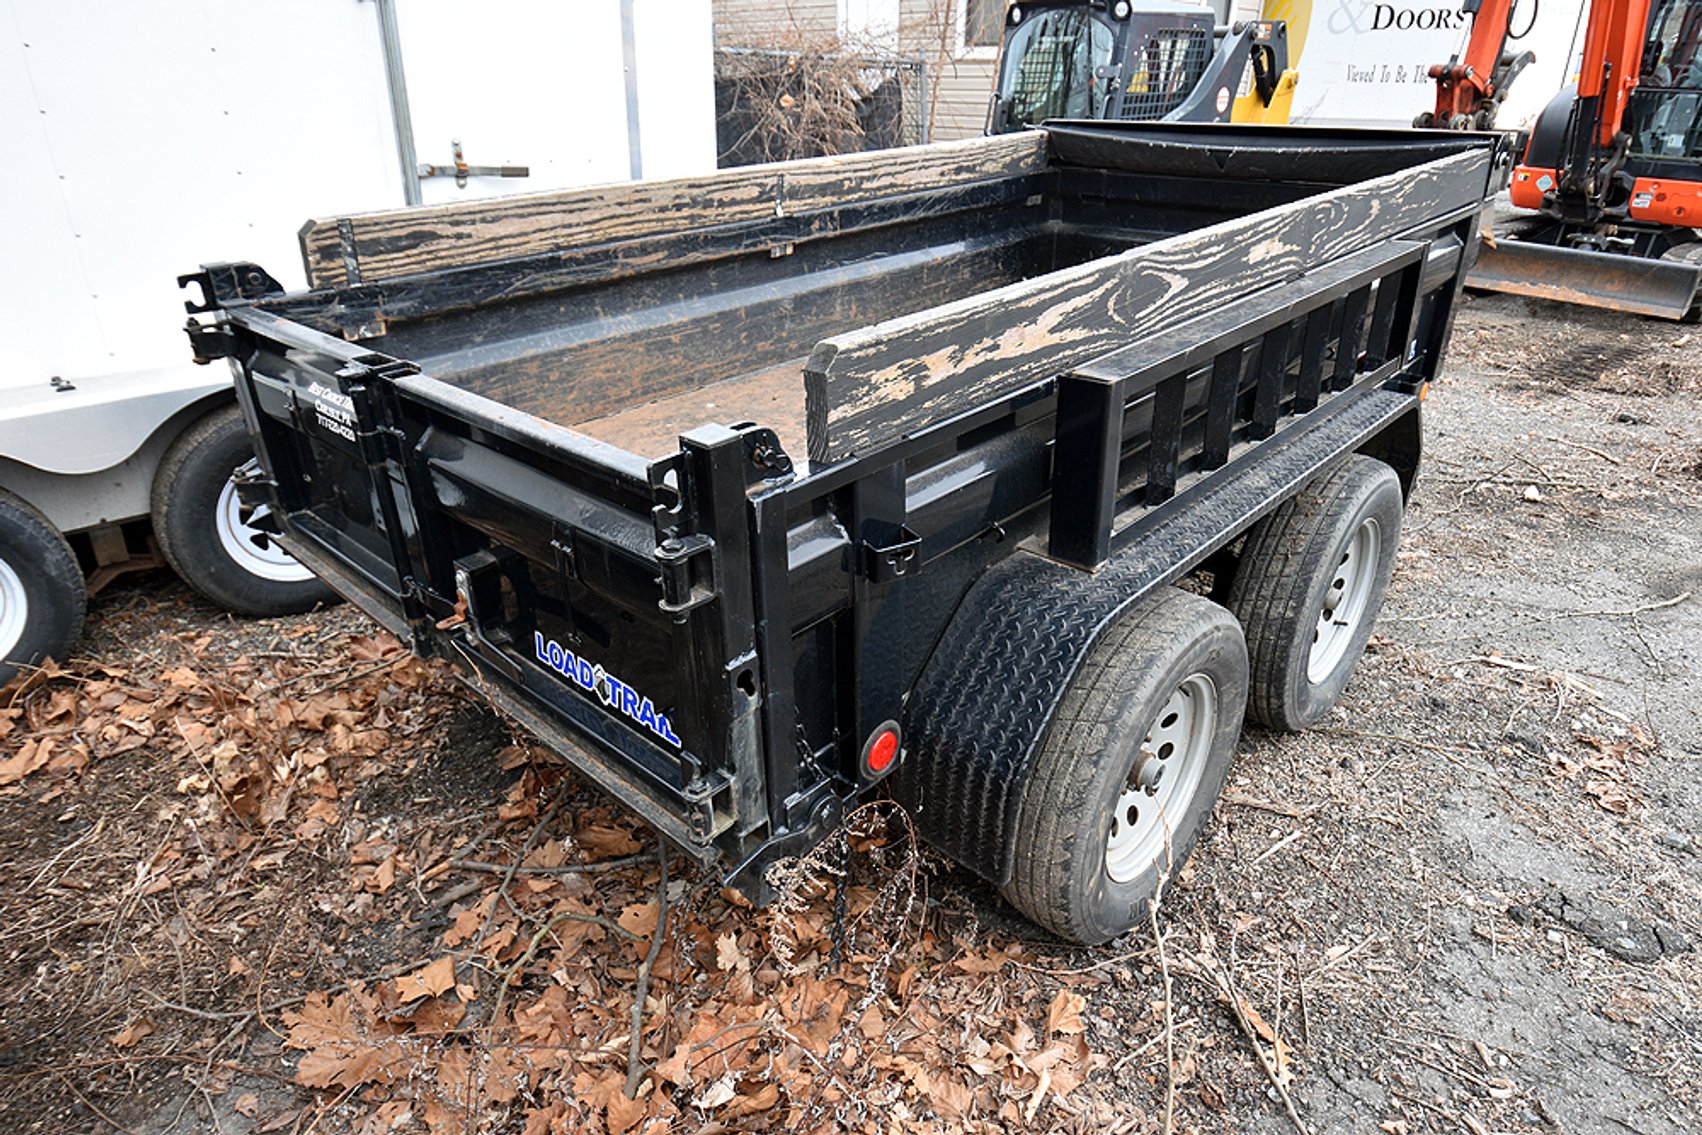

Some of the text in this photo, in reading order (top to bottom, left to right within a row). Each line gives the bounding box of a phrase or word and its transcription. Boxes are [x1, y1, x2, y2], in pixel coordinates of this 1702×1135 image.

[1370, 3, 1465, 30] DOORS
[1379, 64, 1391, 83] To
[1395, 64, 1407, 83] Be
[534, 630, 682, 749] LOAD TRAIL
